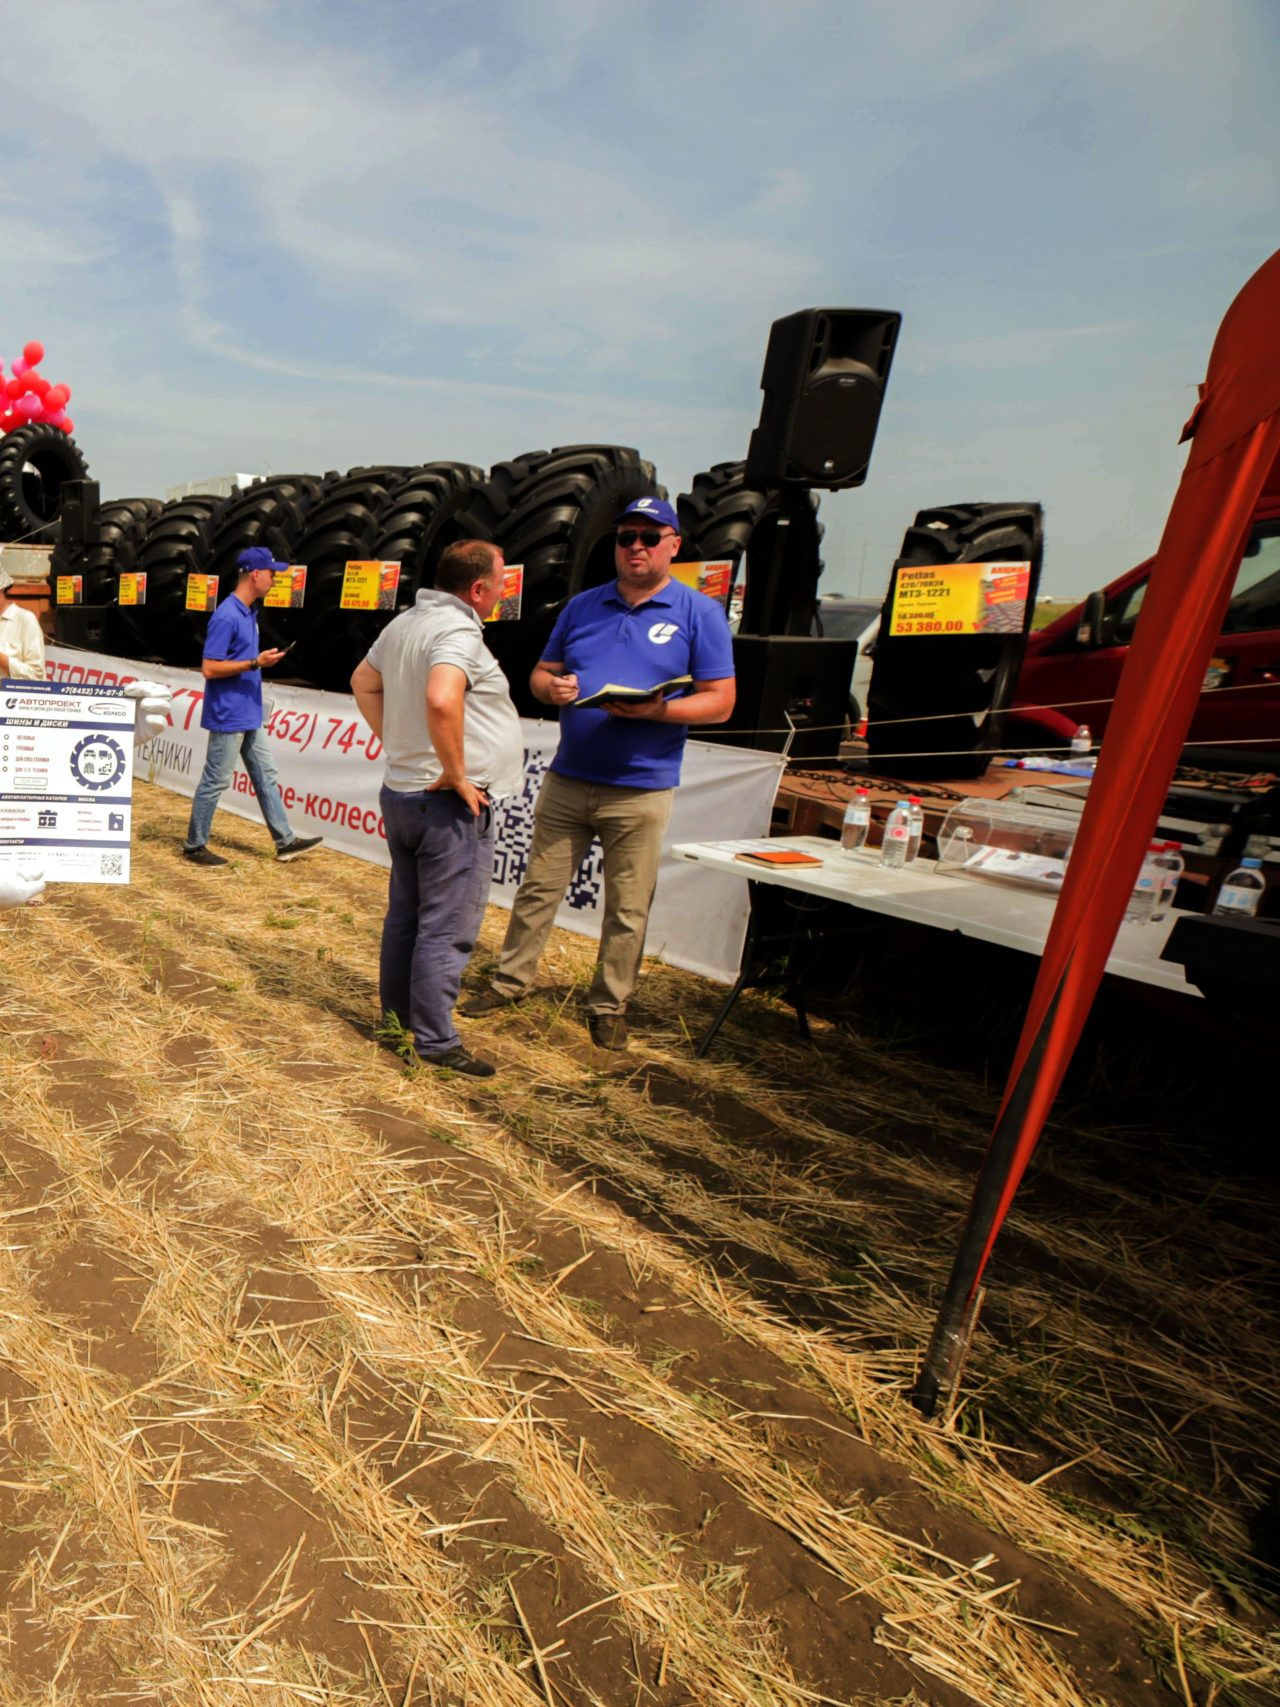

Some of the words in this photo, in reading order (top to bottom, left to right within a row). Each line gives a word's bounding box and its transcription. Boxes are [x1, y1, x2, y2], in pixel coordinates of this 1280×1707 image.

[94, 688, 126, 697] 74-07-0
[19, 698, 82, 707] АВТОПРОЕКТ
[5, 718, 32, 726] ШИНЫ
[40, 720, 69, 728] ДИСКИ
